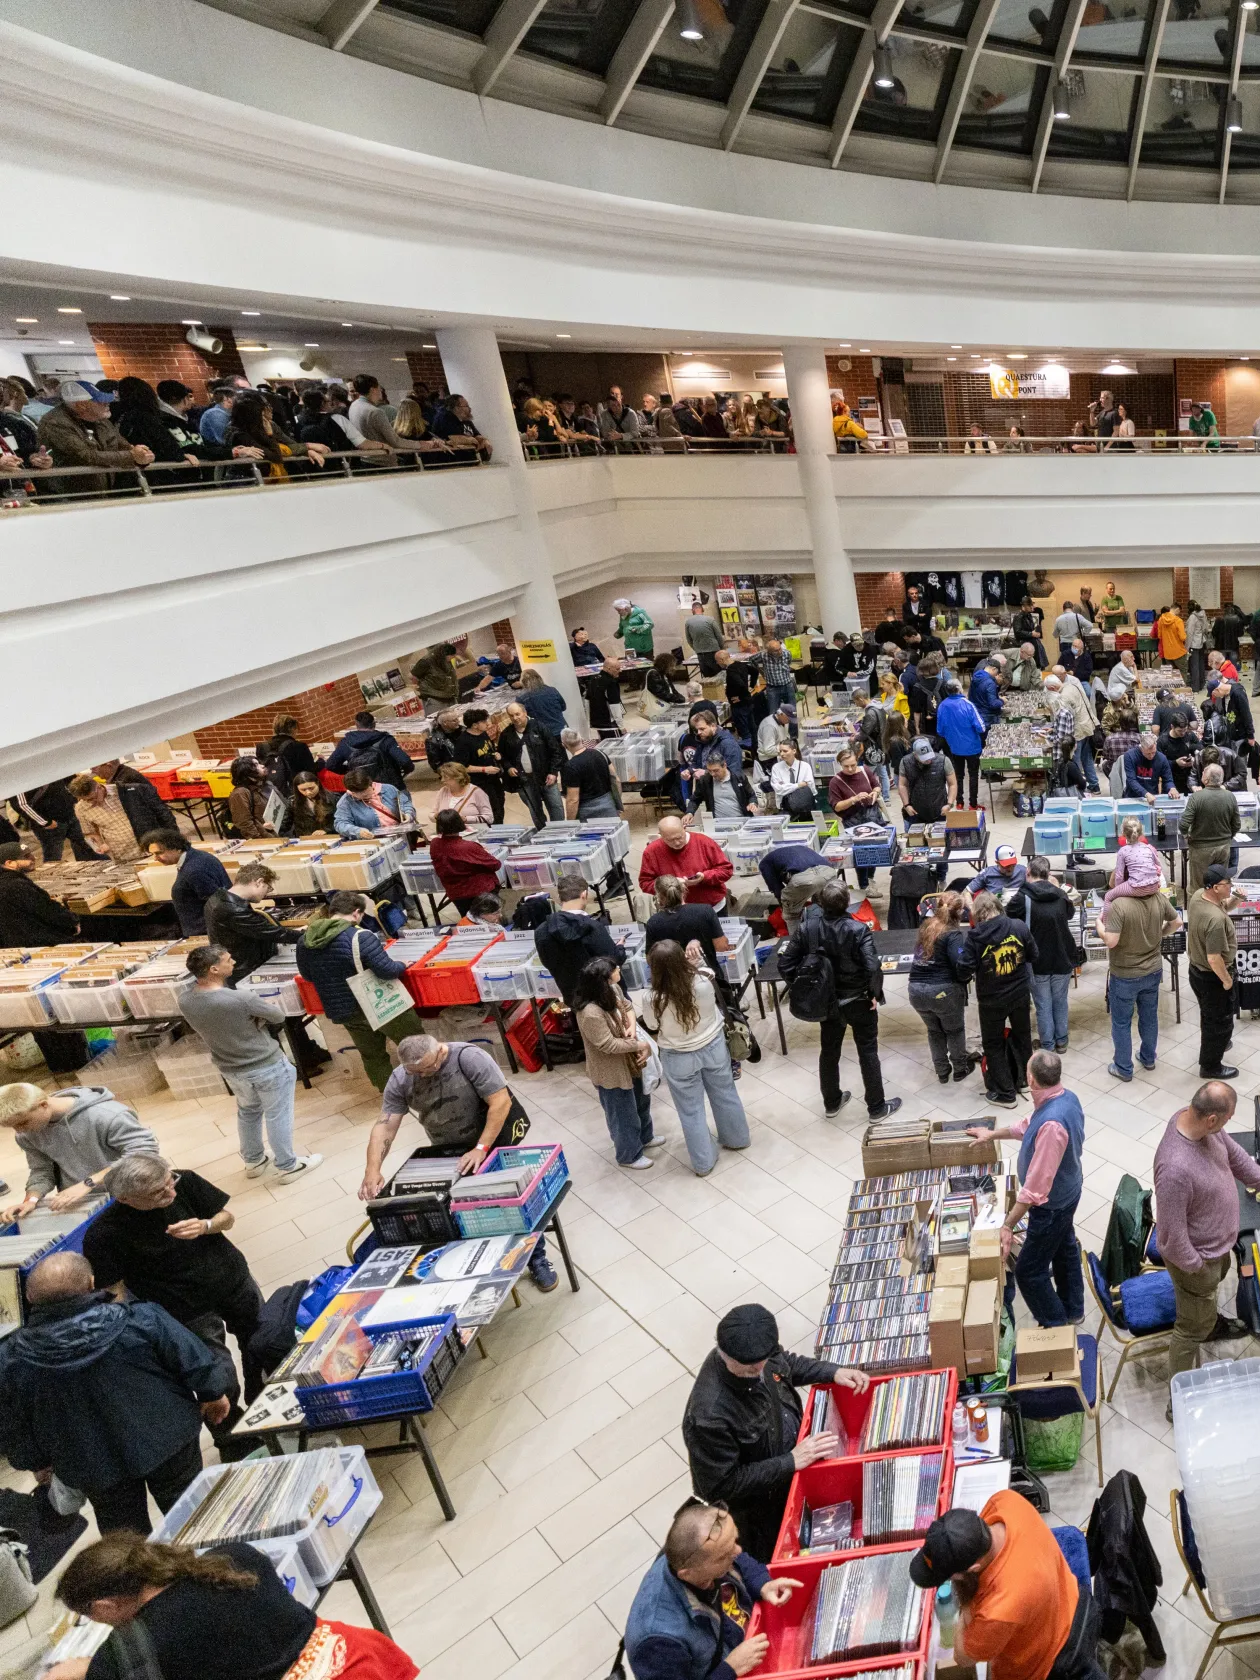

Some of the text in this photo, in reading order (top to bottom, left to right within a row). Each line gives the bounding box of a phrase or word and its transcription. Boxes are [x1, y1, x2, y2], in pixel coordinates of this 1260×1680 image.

[1005, 373, 1047, 381] QUAESTURA
[403, 930, 435, 938] hungarian
[459, 926, 486, 935] újdonság
[369, 1248, 416, 1263] EAST
